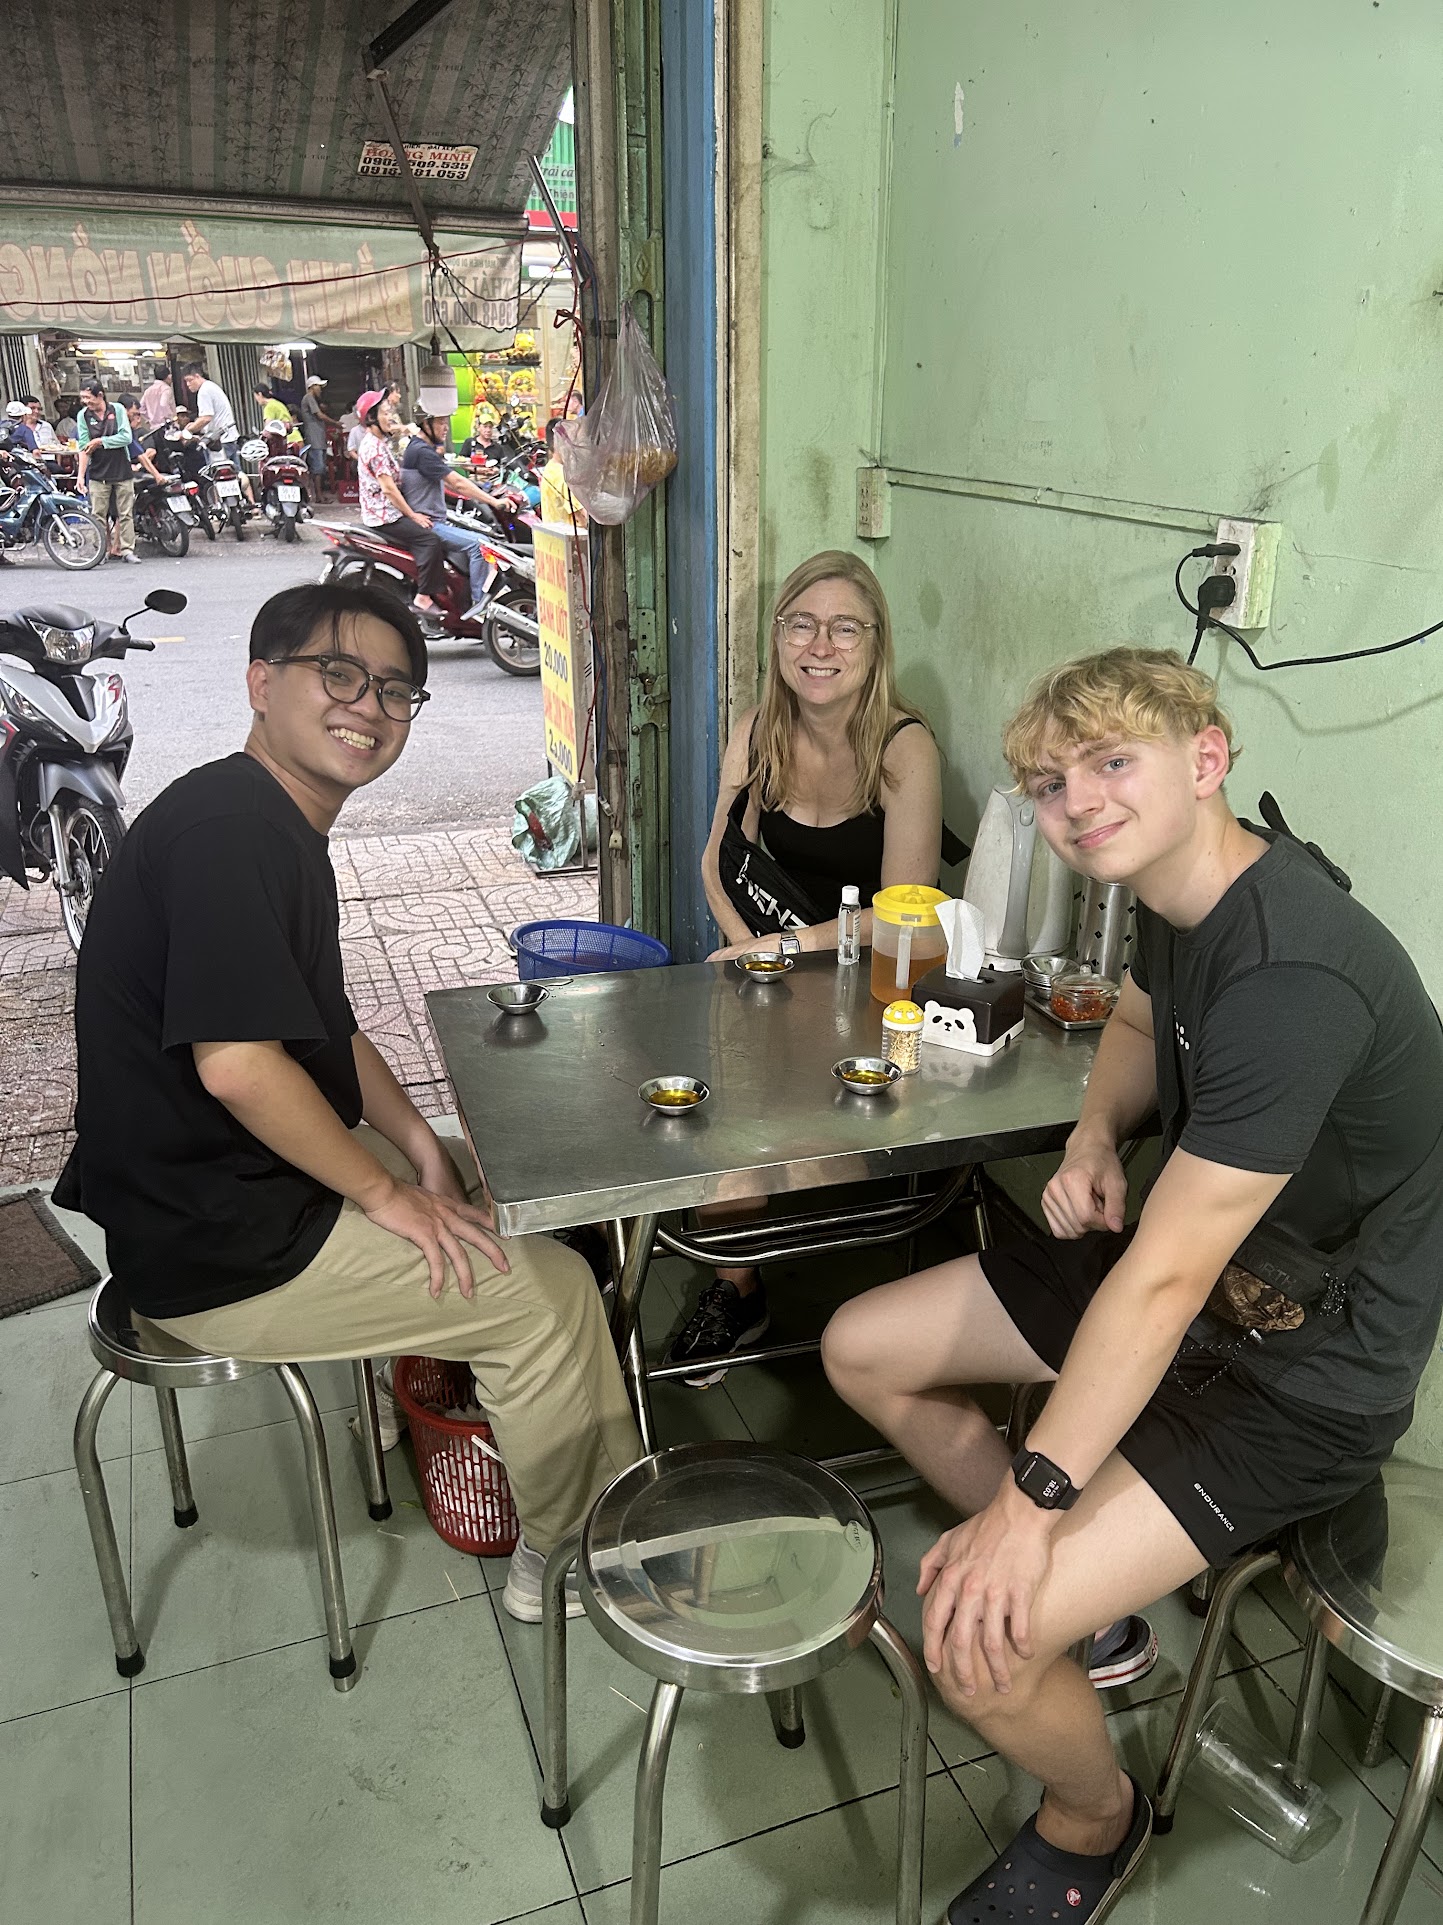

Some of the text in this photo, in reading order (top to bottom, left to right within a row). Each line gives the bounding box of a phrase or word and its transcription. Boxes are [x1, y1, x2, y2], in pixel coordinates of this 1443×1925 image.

[429, 151, 473, 161] MINH
[362, 157, 469, 170] 0902509.535
[360, 165, 467, 180] 0918.81.053
[1193, 1482, 1235, 1532] ENDURANCE
